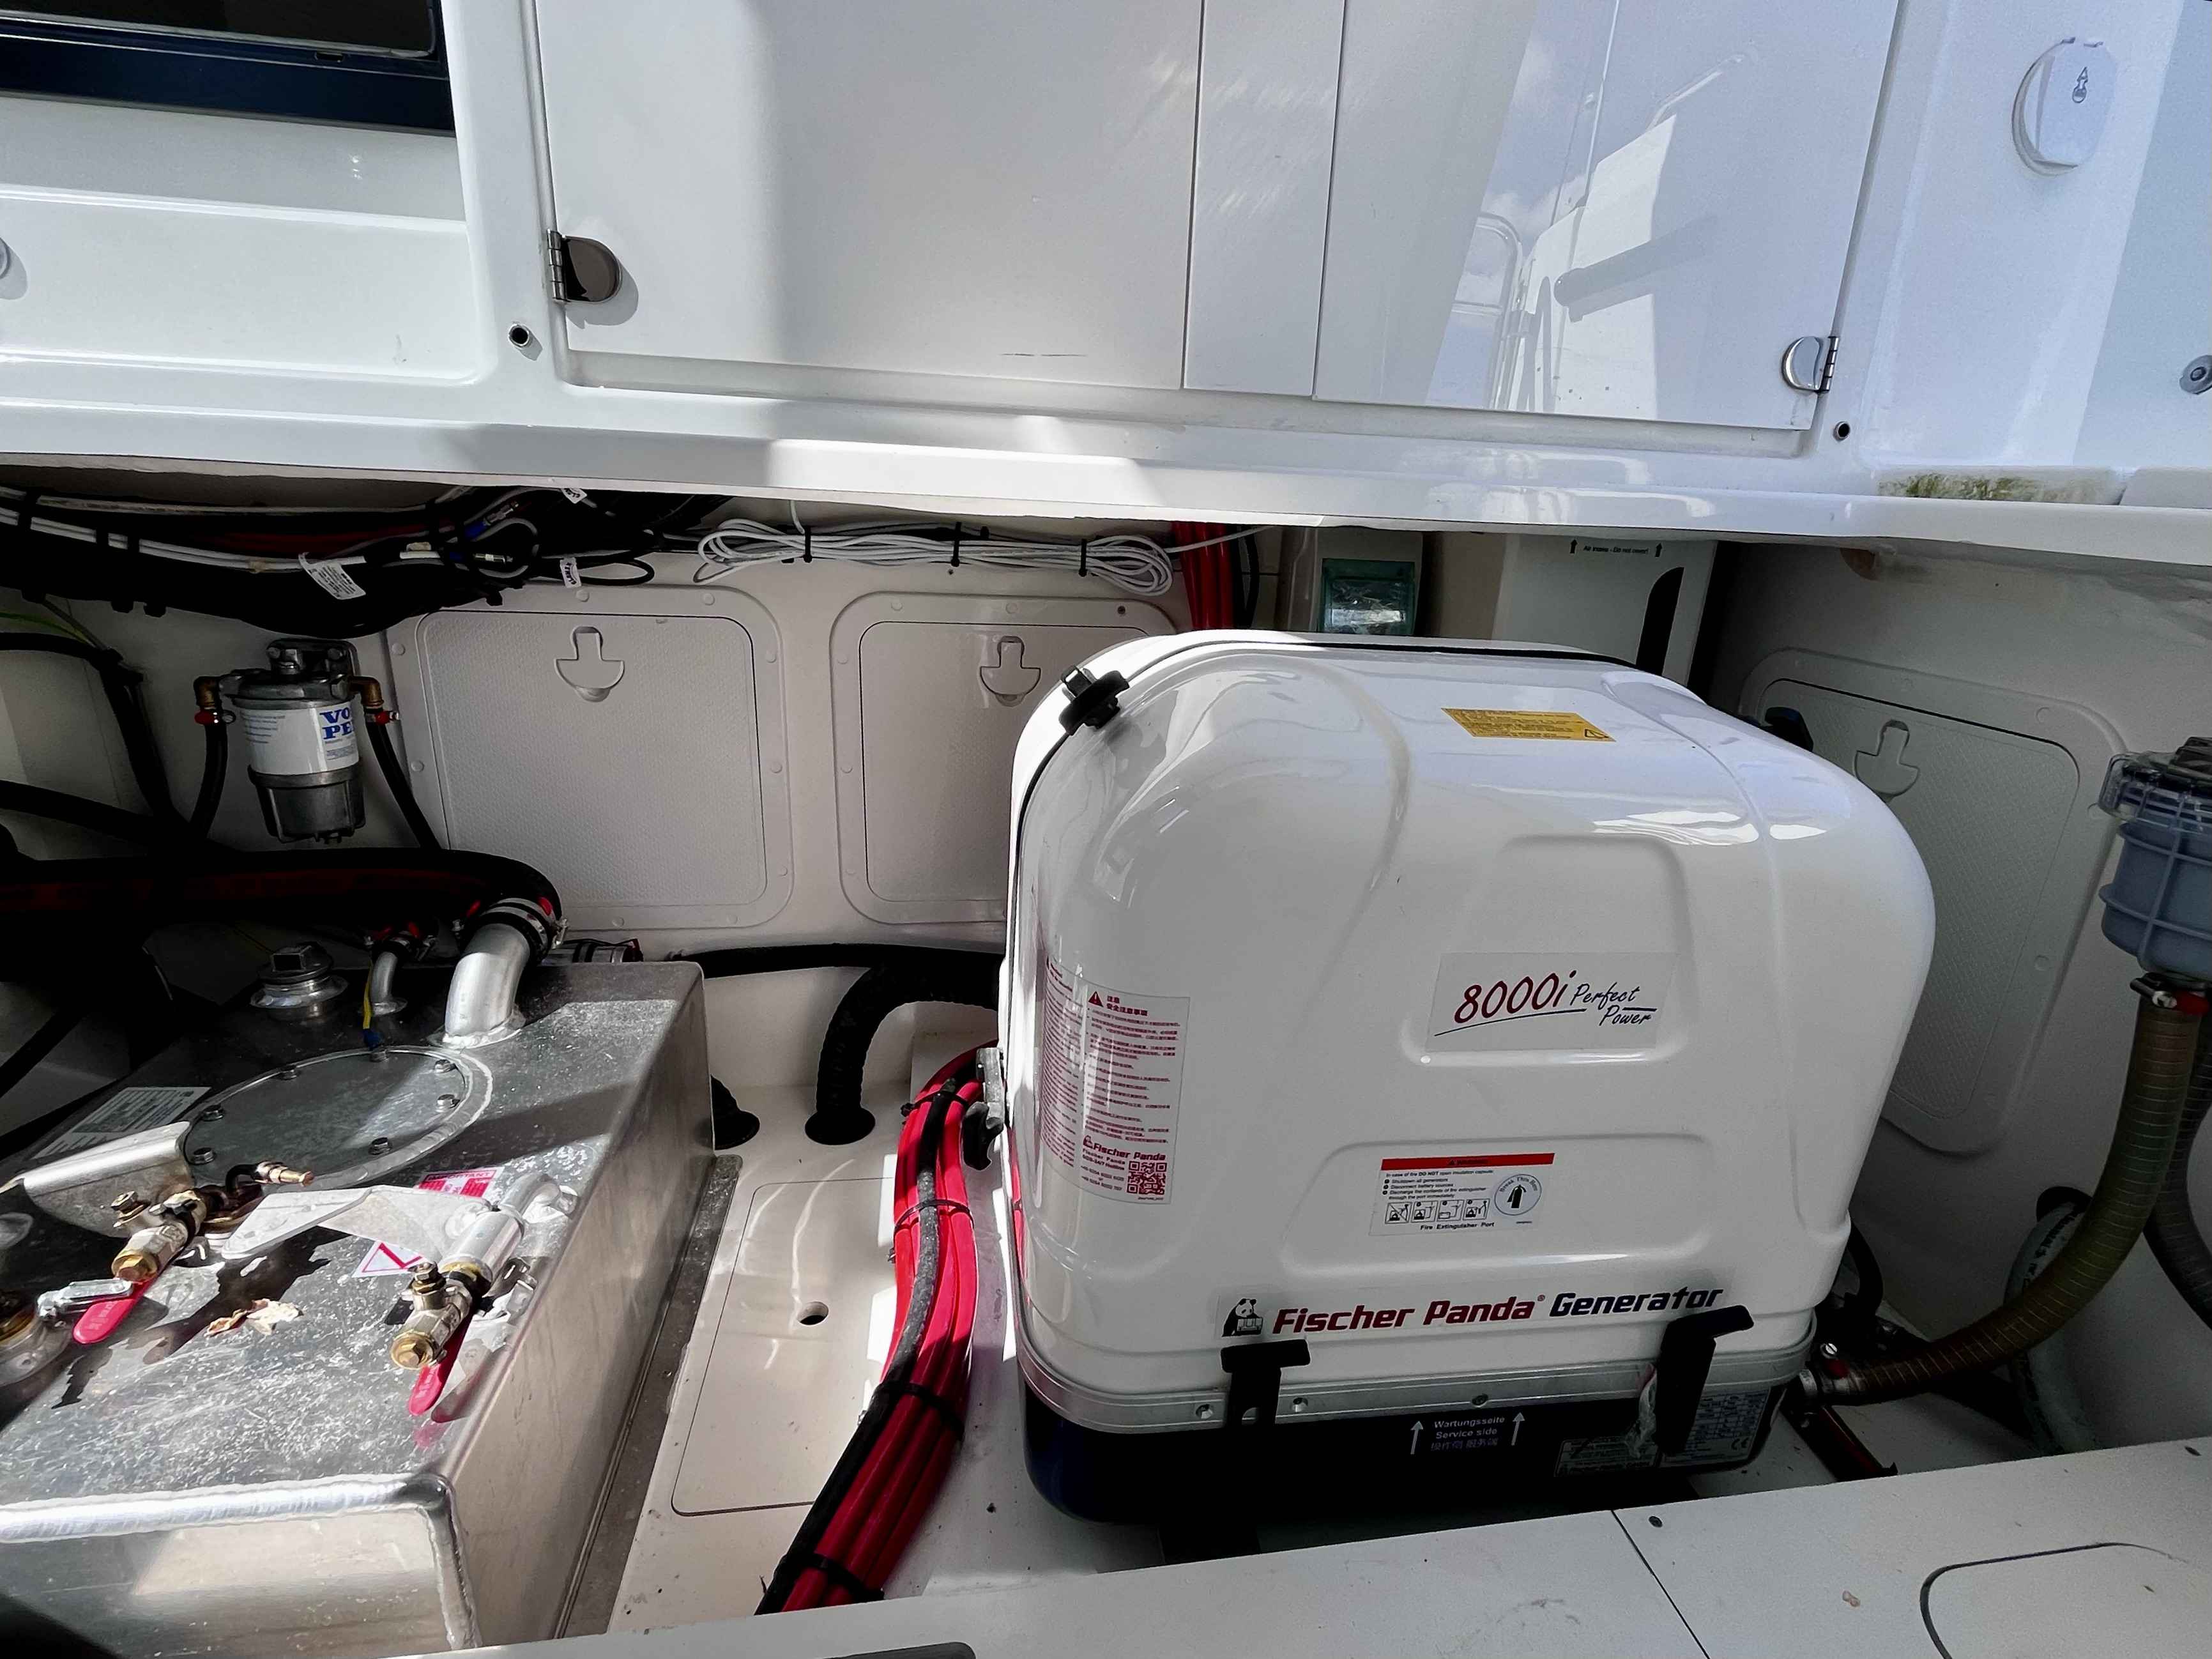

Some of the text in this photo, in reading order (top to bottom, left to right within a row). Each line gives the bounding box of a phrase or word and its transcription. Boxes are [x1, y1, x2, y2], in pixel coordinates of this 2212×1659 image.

[1454, 970, 1641, 1024] 8000i Perfect
[1599, 1005, 1652, 1026] Power
[1093, 1142, 1166, 1161] Fischer Panda
[1272, 1304, 1415, 1334] Fischer
[1549, 1286, 1724, 1317] Generator
[1433, 1416, 1506, 1429] Wartungsseite
[1435, 1428, 1498, 1440] Service side
